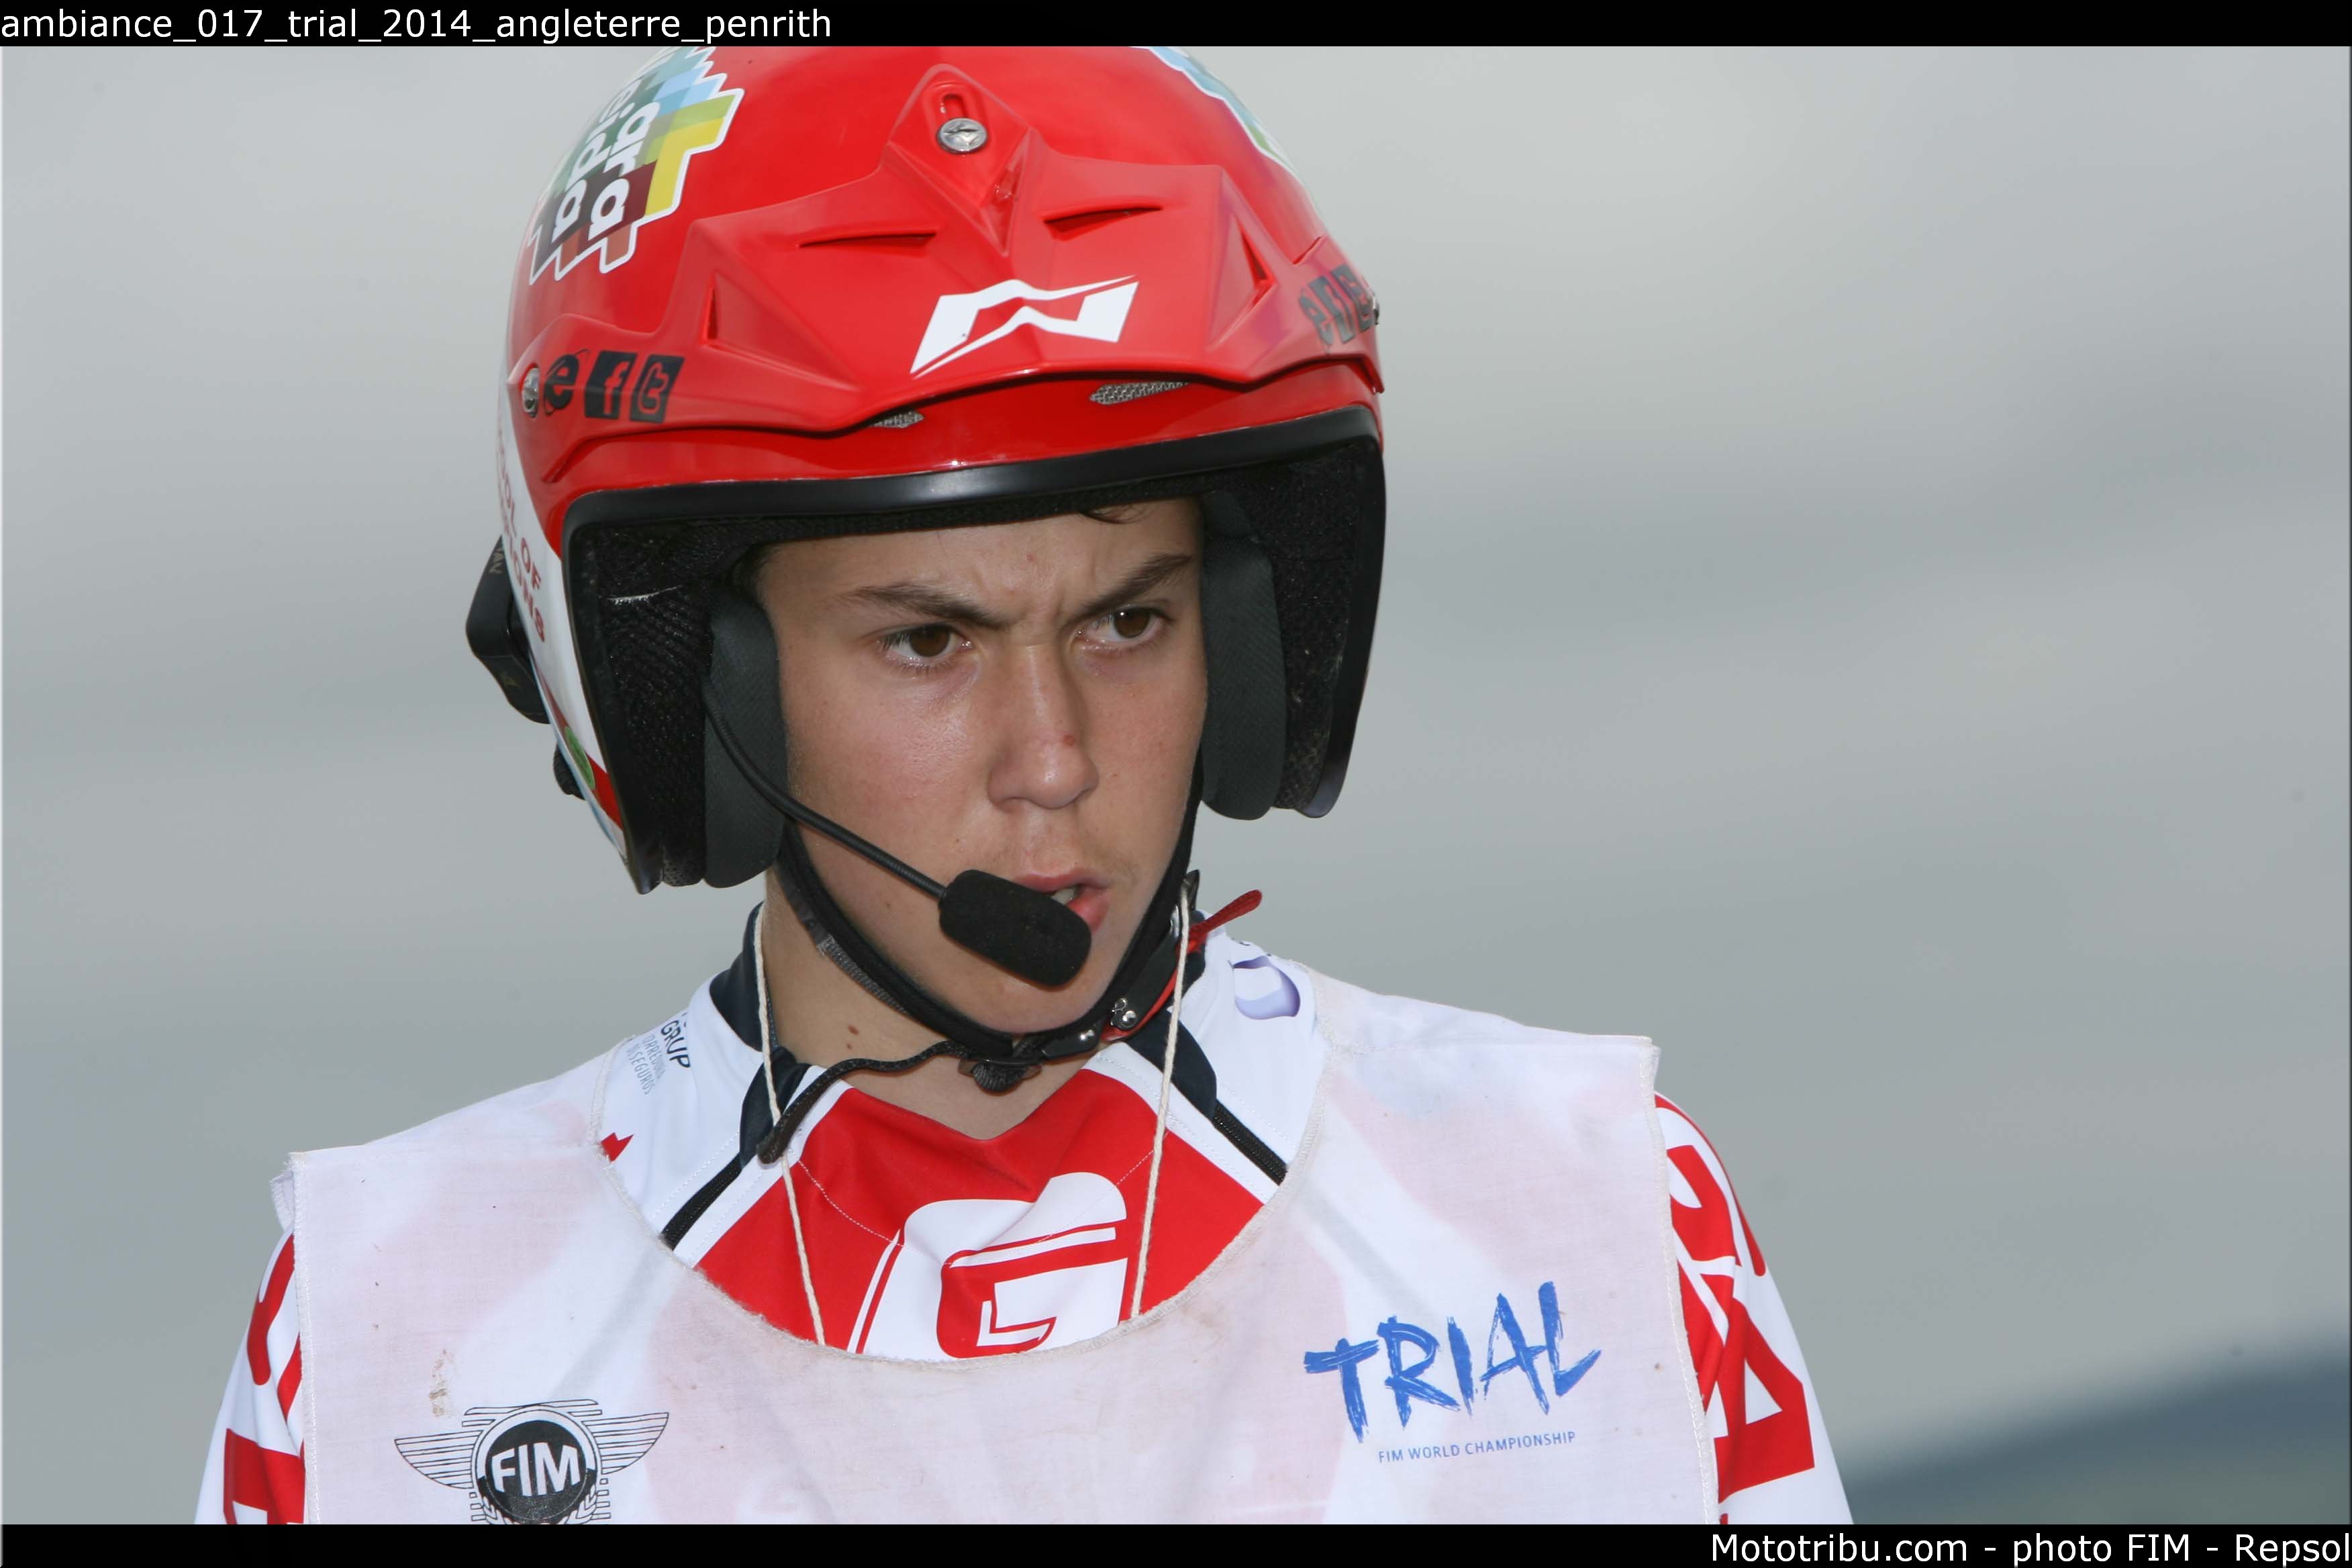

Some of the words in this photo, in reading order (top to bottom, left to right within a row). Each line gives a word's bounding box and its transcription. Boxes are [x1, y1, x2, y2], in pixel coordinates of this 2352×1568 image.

[1304, 1281, 1602, 1444] TRIAL
[491, 1441, 581, 1498] FIM
[1378, 1450, 1404, 1463] FIM
[1408, 1443, 1461, 1460] WORLD
[1465, 1431, 1577, 1455] CHAMPIONSHIP
